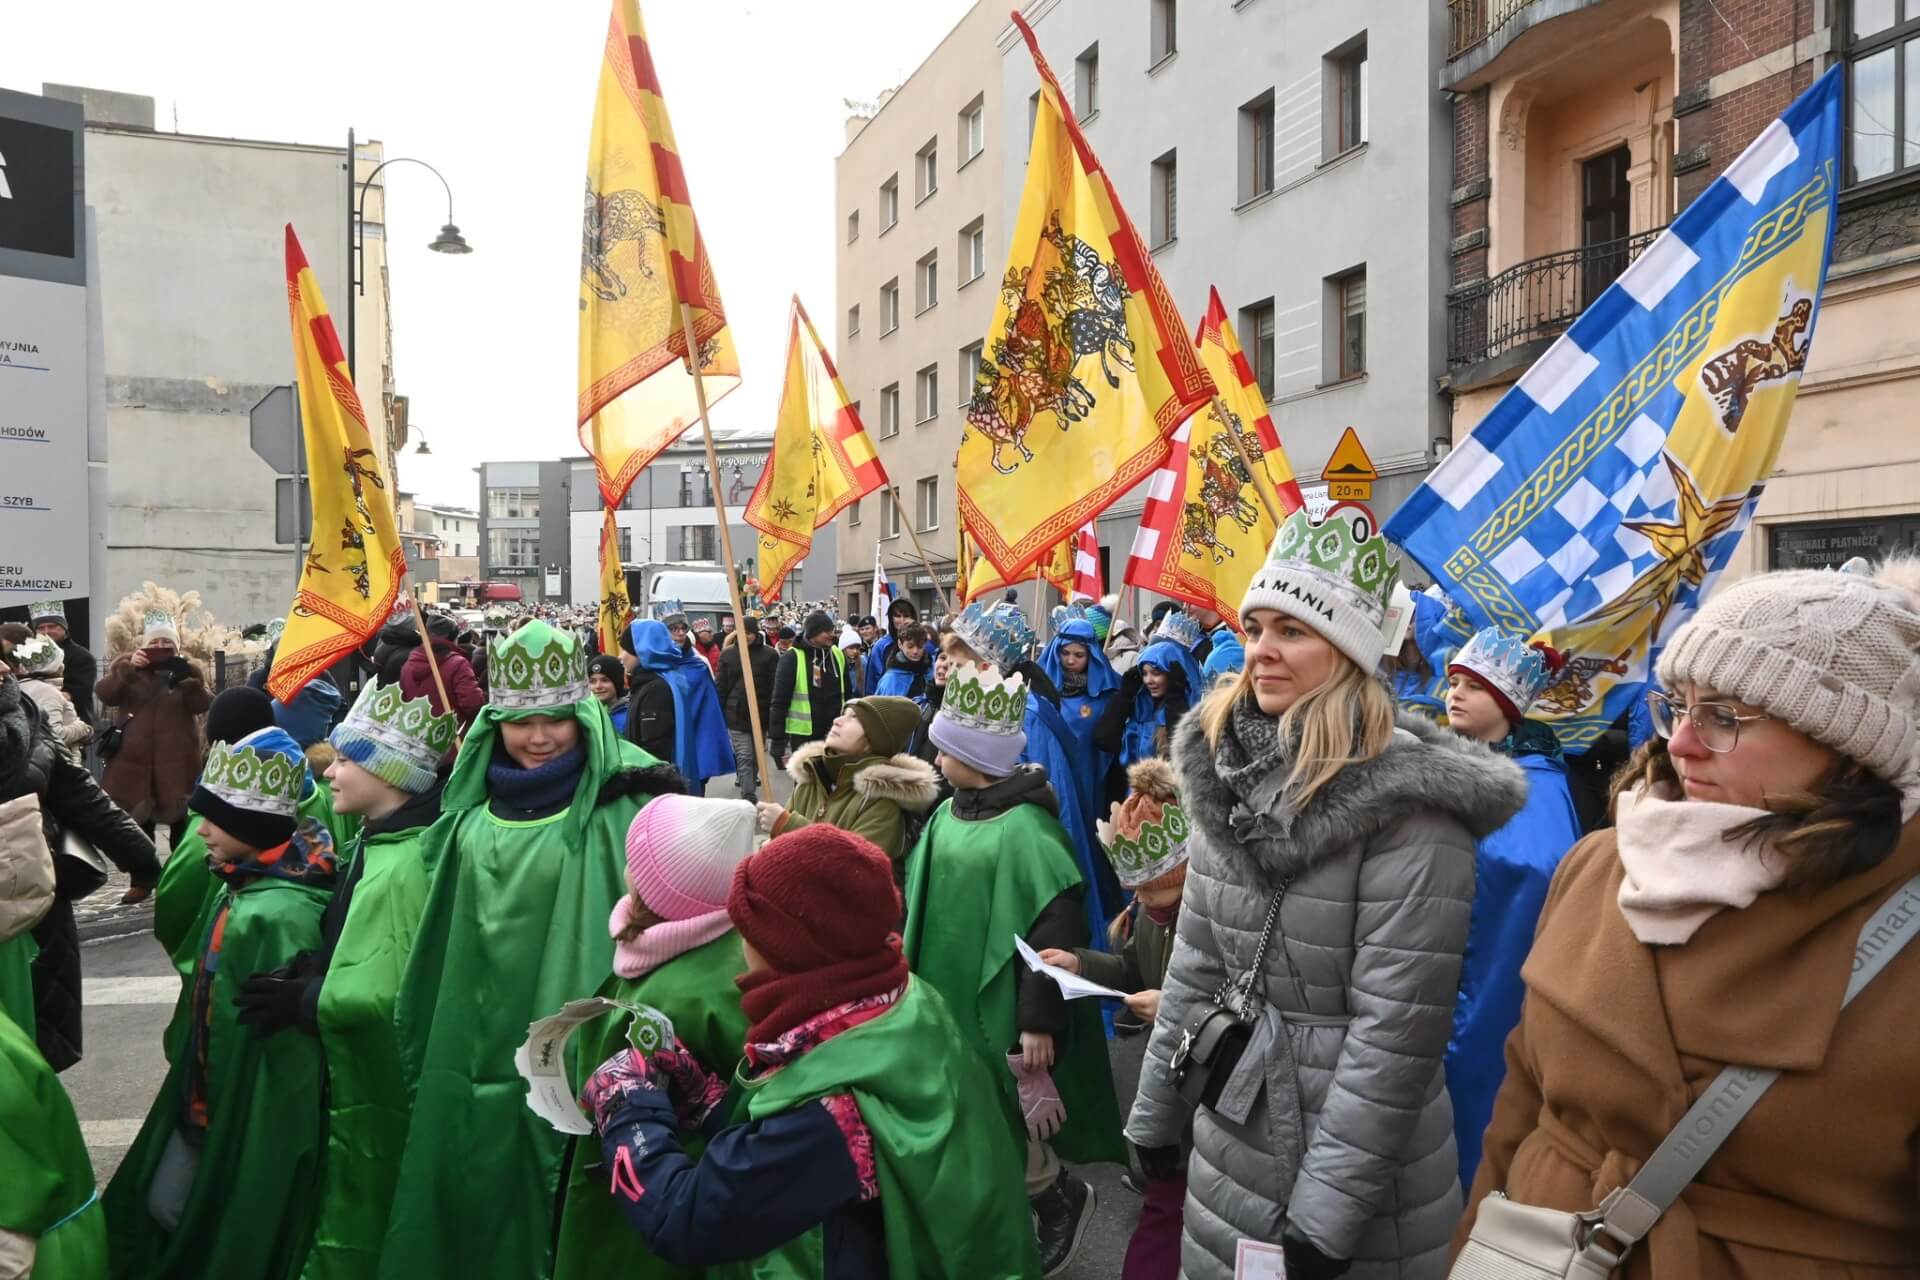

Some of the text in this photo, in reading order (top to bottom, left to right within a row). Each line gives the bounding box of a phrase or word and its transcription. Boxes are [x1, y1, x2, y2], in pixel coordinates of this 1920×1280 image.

[1, 426, 45, 438] HODÓW
[727, 456, 750, 468] your
[1336, 485, 1351, 496] 20
[3, 496, 33, 506] SZYB
[1272, 580, 1334, 622] MANIA
